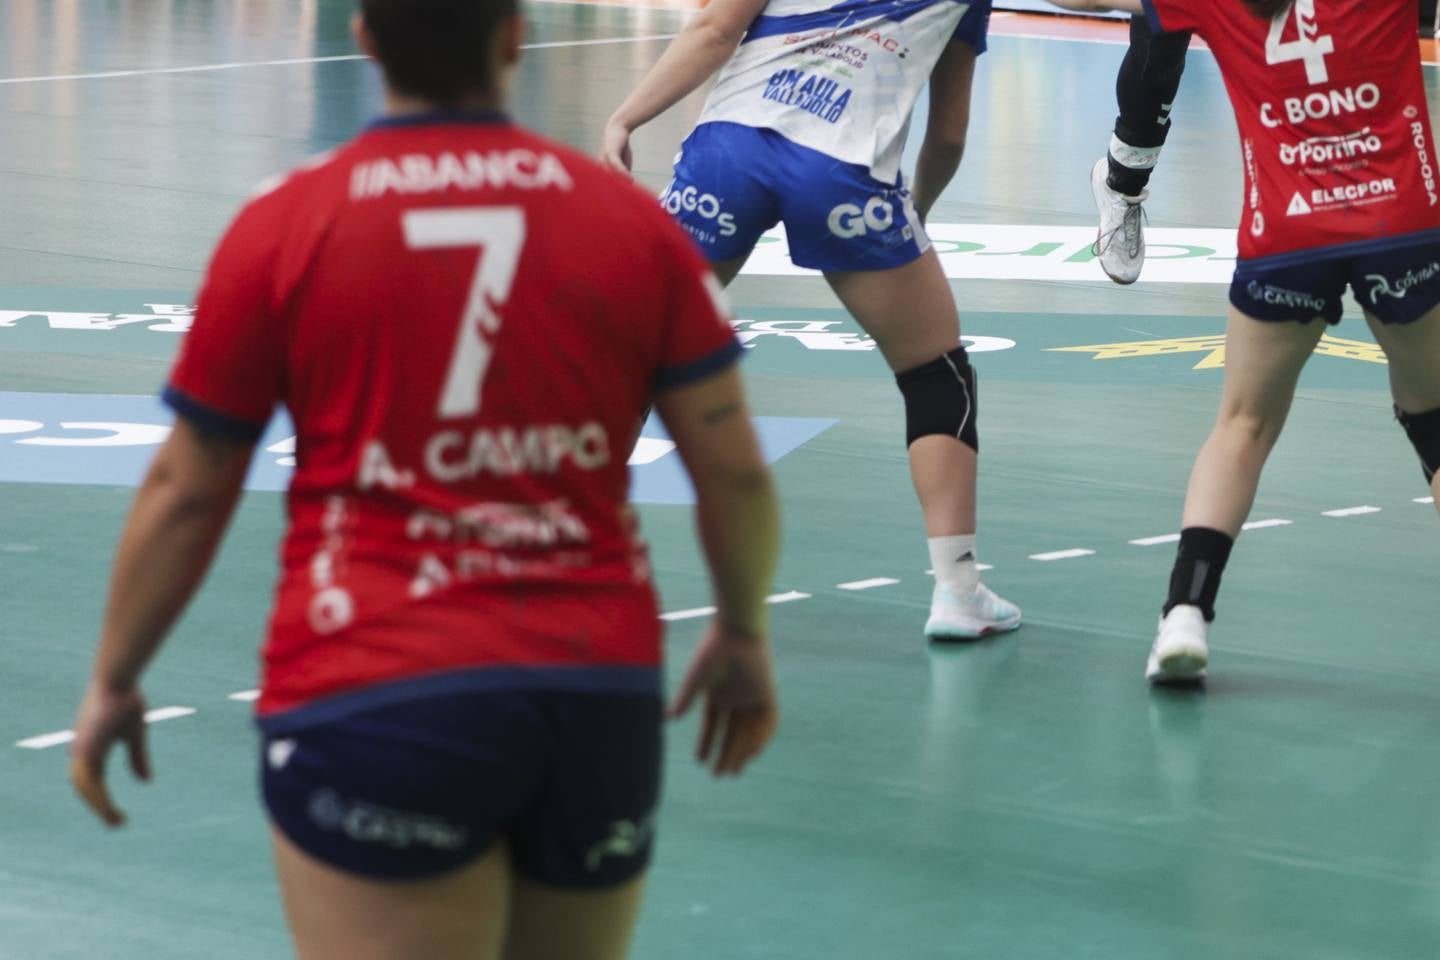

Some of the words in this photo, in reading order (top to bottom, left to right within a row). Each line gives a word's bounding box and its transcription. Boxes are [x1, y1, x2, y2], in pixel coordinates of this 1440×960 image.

[761, 83, 844, 124] VALLADOLID
[799, 74, 853, 109] AULA
[1259, 102, 1283, 129] C.
[1284, 82, 1381, 125] BONO
[1410, 120, 1438, 207] RODOSA
[1311, 178, 1396, 205] ELECPOR
[403, 206, 527, 419] 7
[356, 439, 416, 492] A.
[424, 421, 611, 483] CAMPO
